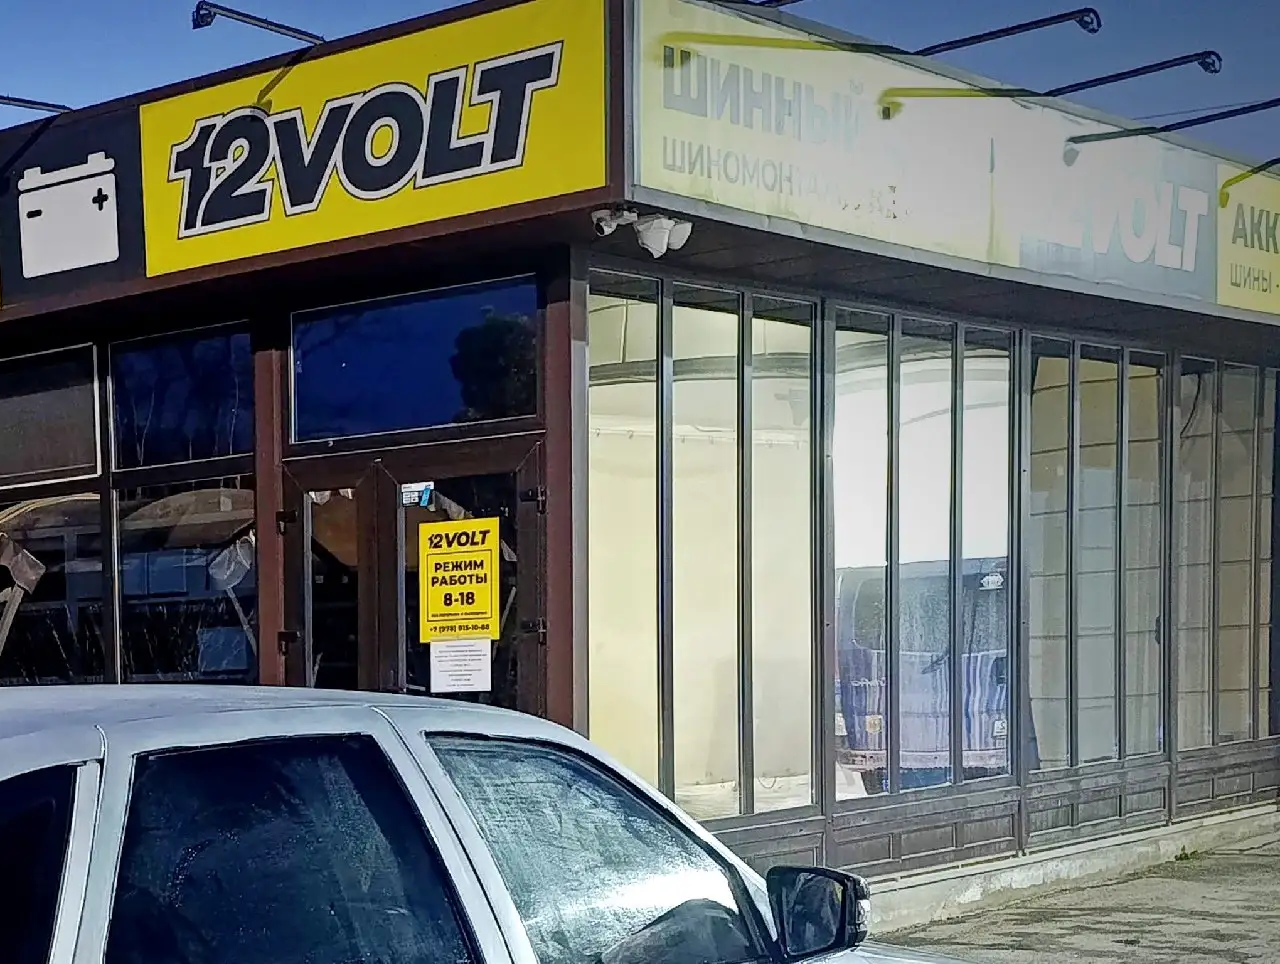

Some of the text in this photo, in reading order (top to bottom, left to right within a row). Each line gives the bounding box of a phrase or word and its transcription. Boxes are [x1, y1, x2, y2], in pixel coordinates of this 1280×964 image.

[168, 40, 563, 240] 12VOLT
[1230, 263, 1272, 294] ШИНЫ
[428, 529, 491, 549] 12VOLT
[434, 560, 484, 573] РЕЖИМ
[431, 573, 487, 588] РАБОТЫ
[443, 592, 476, 607] 8-18
